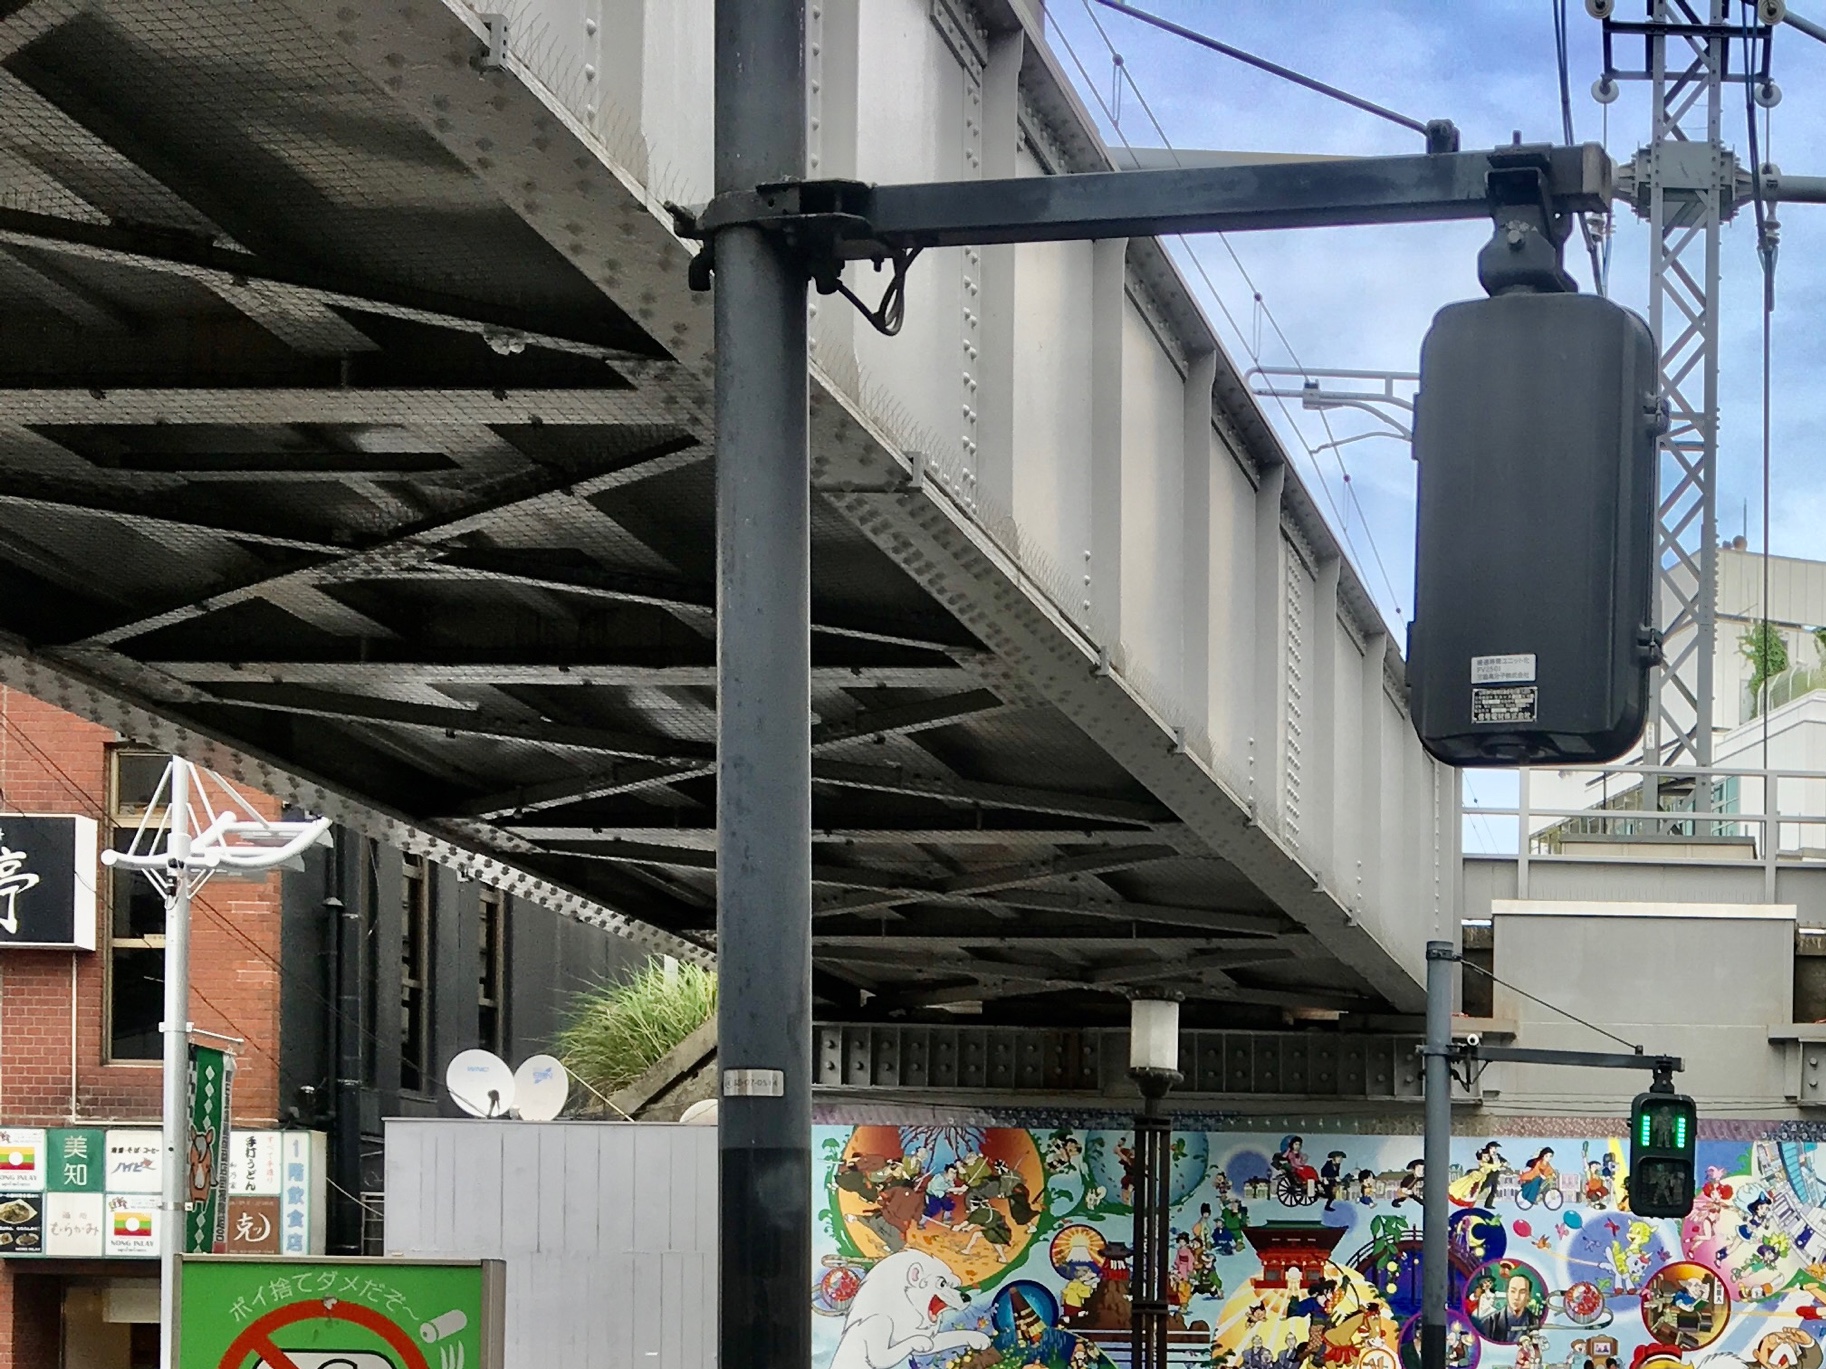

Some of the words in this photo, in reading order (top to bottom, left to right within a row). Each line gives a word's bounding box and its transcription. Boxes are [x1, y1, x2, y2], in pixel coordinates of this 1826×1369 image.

[64, 1135, 88, 1186] 美知
[245, 1136, 257, 1191] 手打うどん
